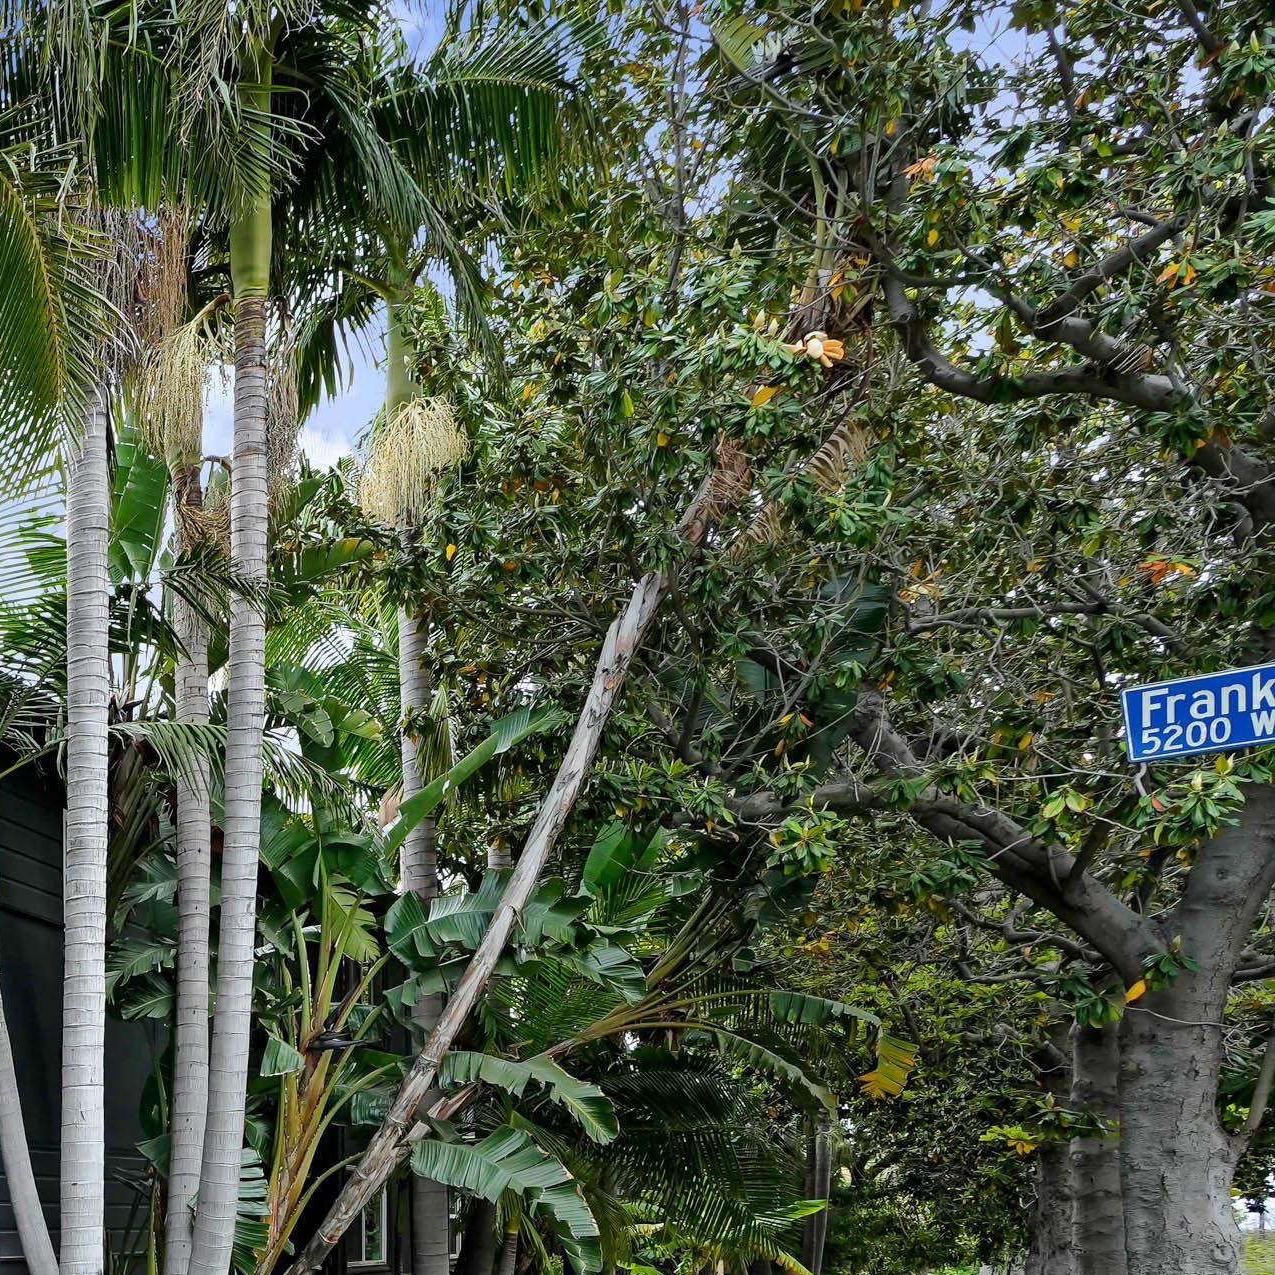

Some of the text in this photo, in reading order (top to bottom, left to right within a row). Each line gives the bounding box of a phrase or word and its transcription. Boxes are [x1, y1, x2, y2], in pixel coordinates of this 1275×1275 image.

[1142, 672, 1275, 727] Frank
[1142, 709, 1275, 754] 5200 W
